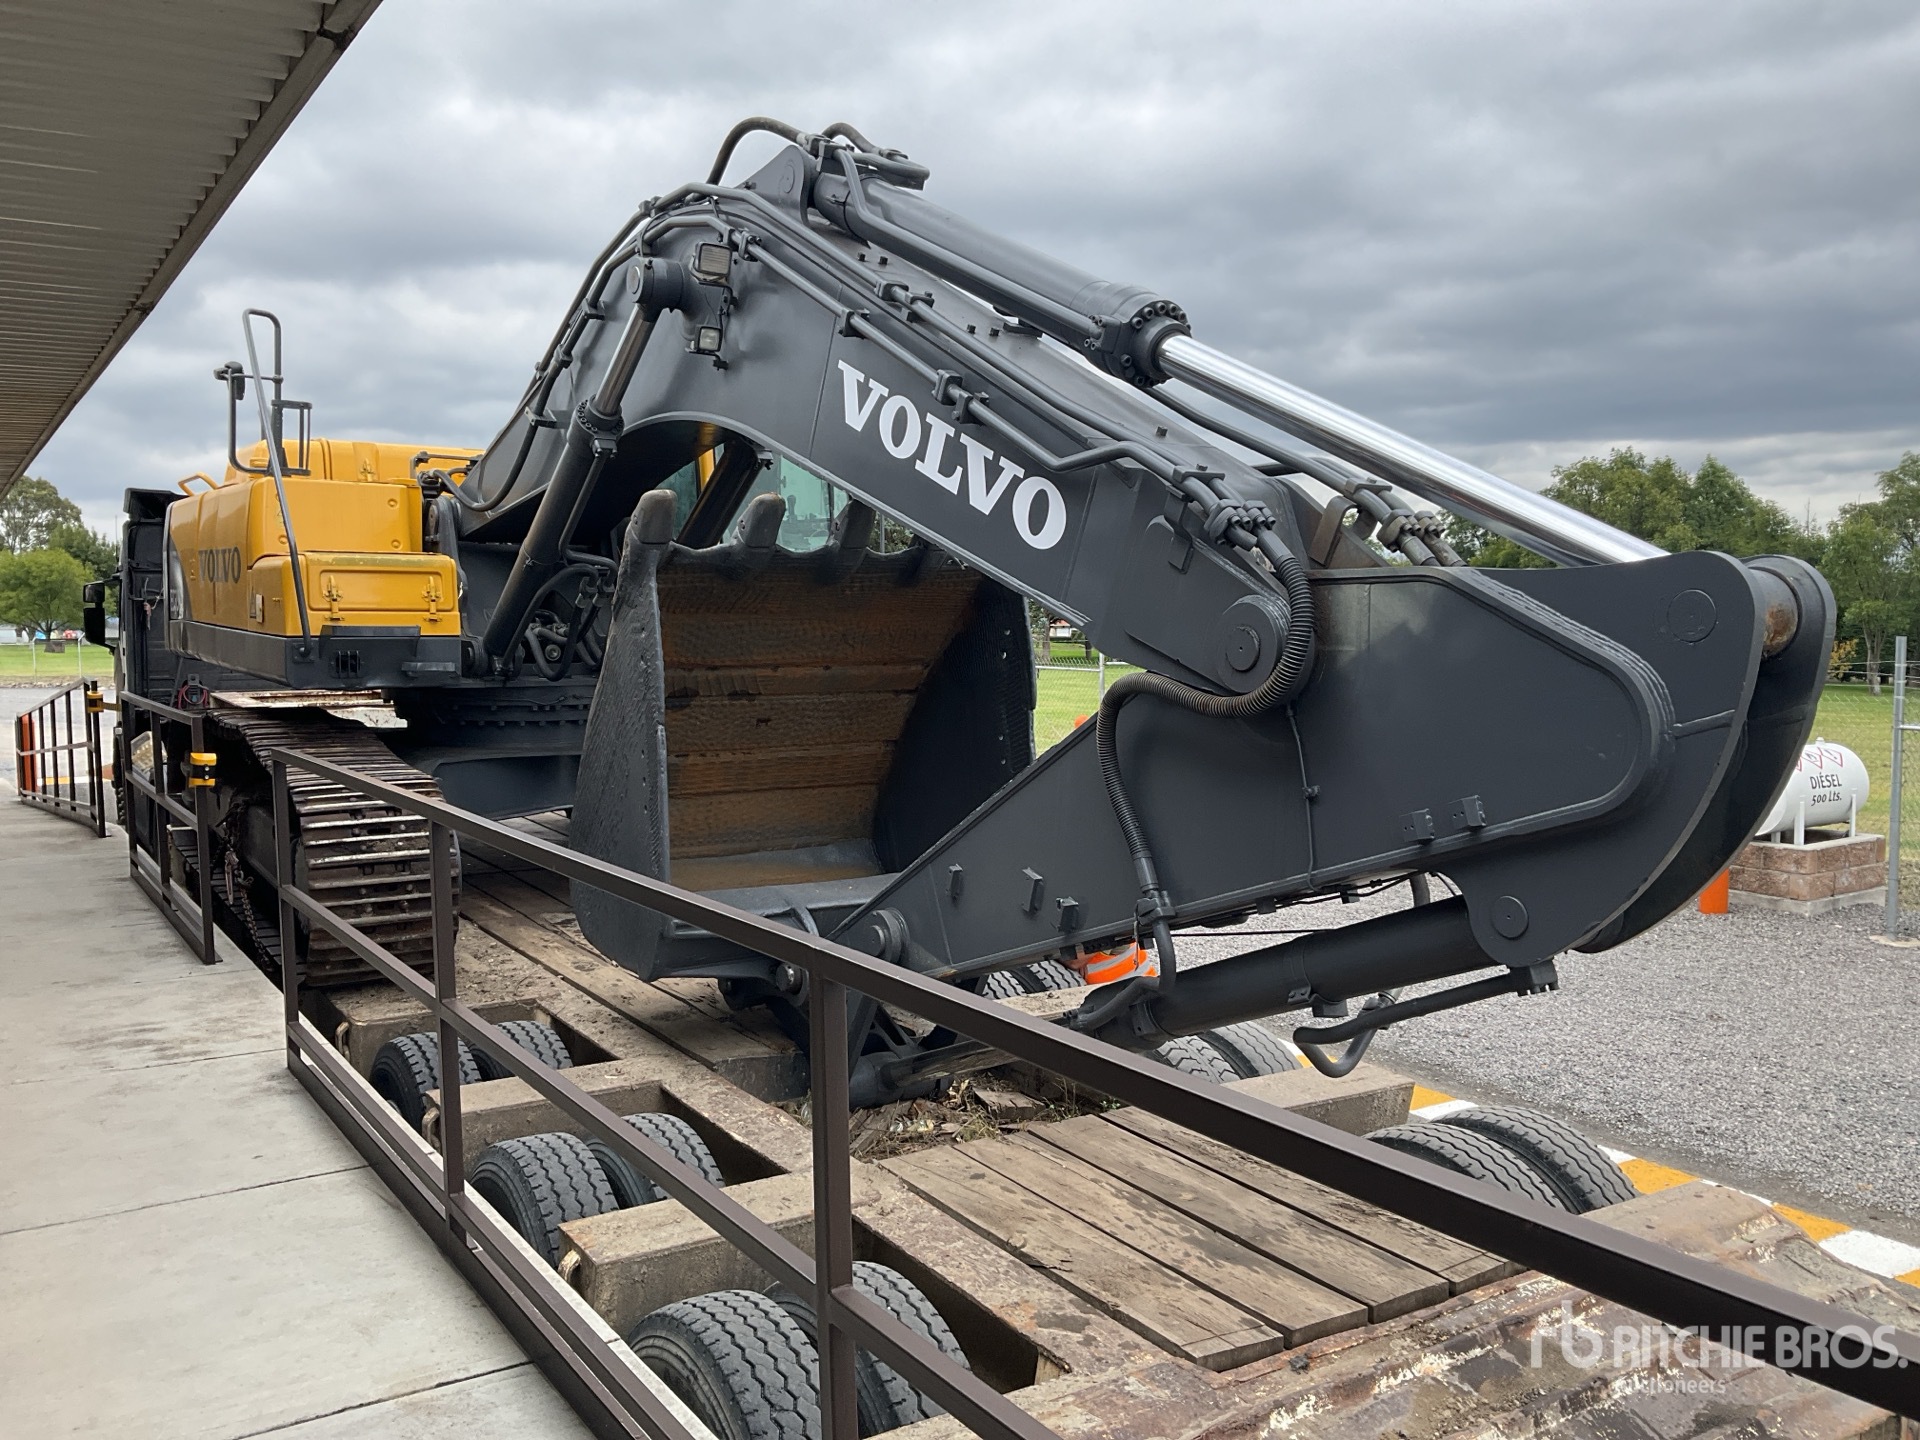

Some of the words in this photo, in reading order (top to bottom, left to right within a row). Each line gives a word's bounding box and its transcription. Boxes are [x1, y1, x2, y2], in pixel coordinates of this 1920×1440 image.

[838, 360, 1067, 549] VOLVO
[198, 546, 241, 584] VOLVO
[1810, 772, 1842, 789] DIÉSEL
[1811, 794, 1827, 806] 500
